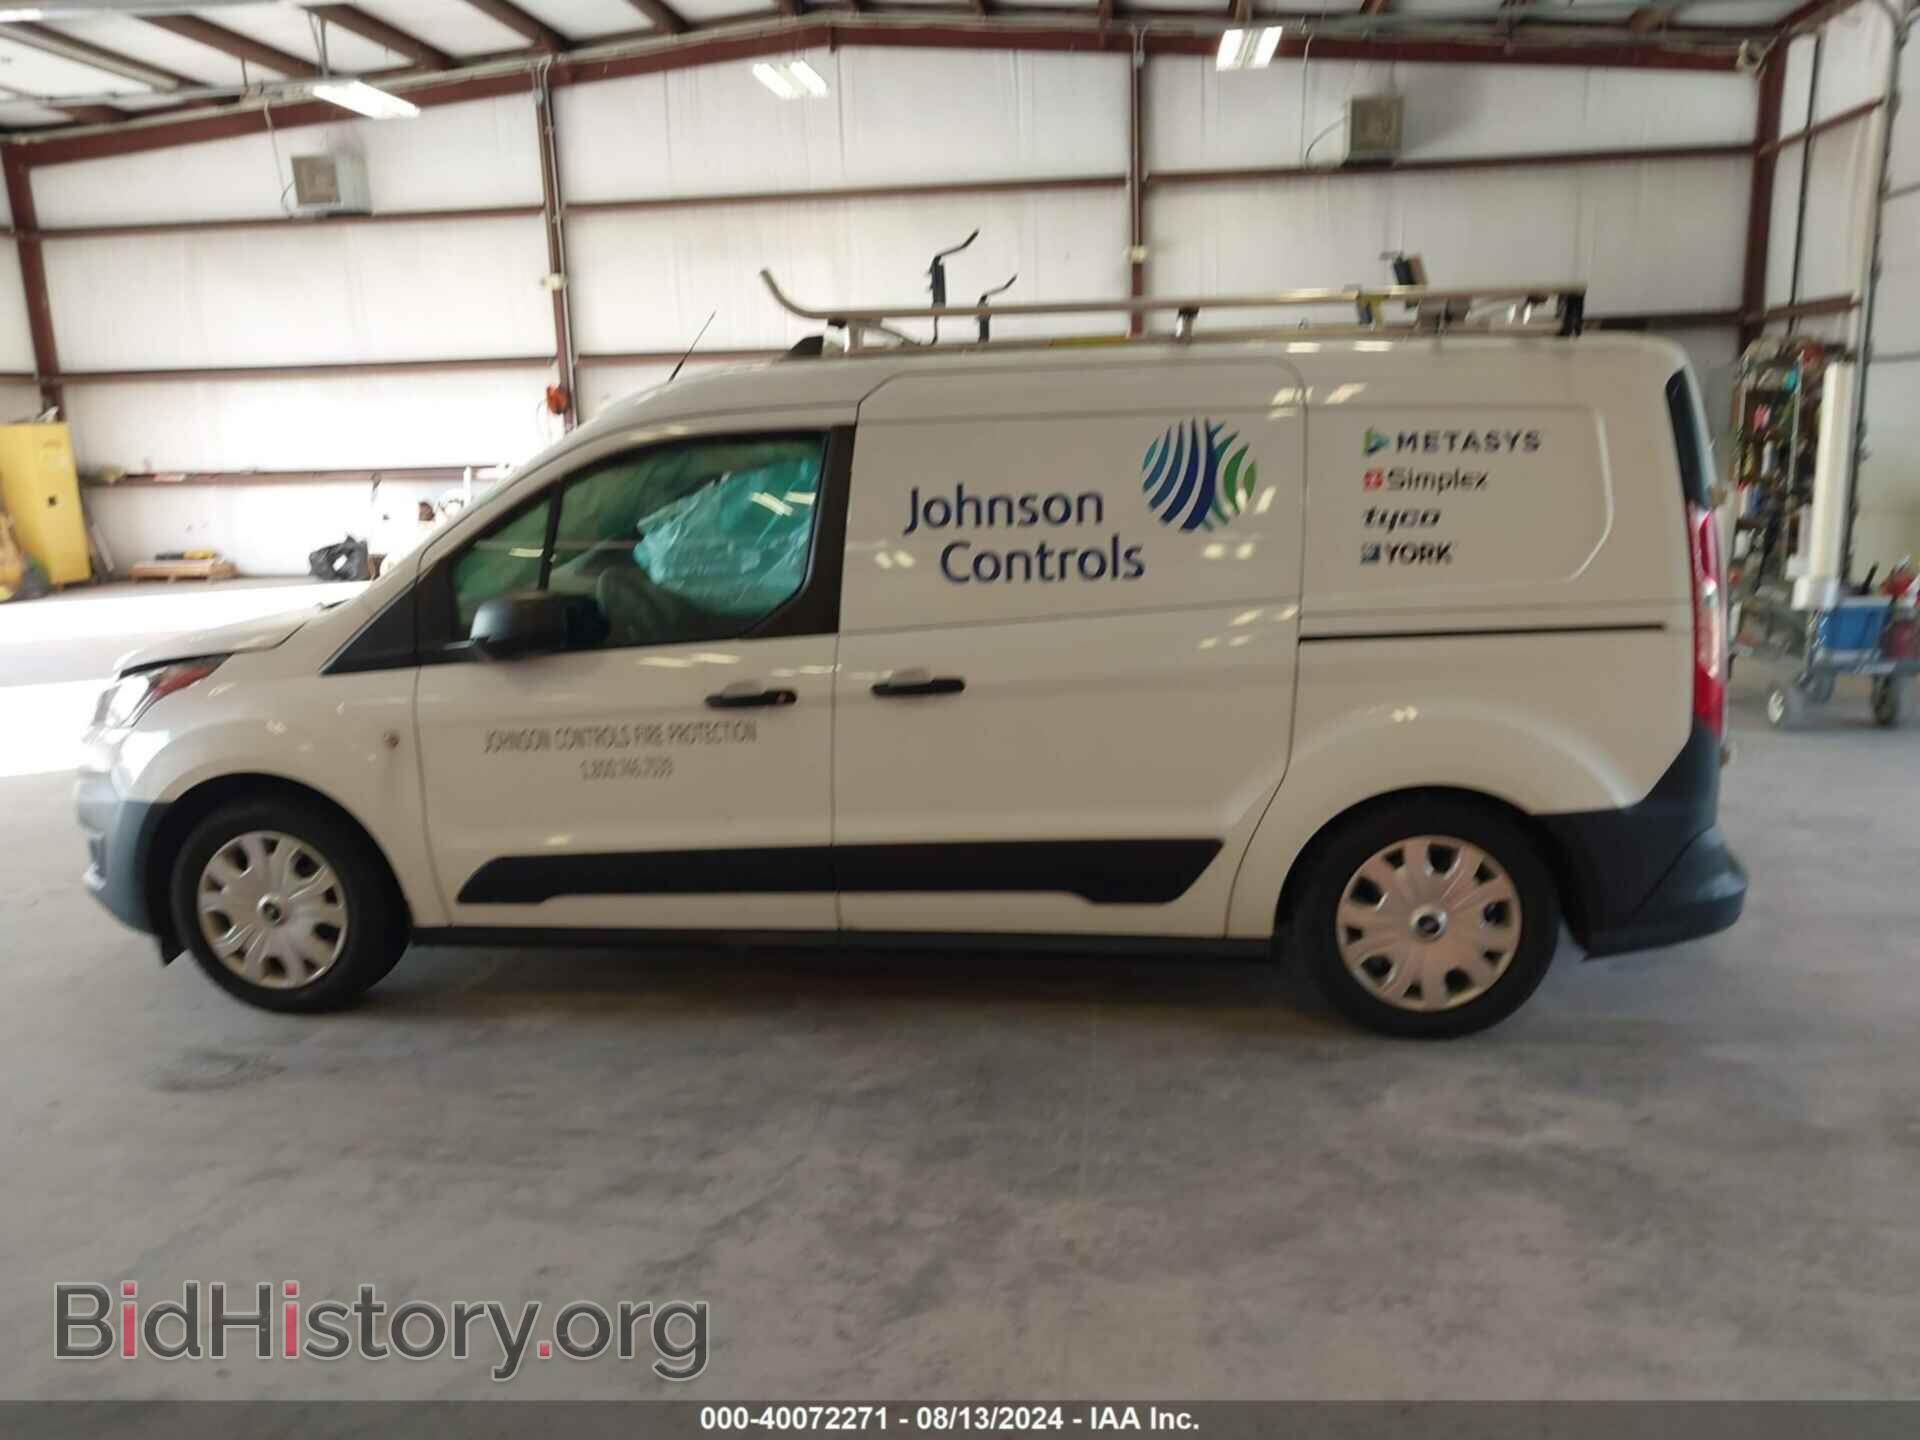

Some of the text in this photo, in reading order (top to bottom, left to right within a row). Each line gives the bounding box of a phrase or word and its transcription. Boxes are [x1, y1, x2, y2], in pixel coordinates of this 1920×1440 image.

[1396, 430, 1542, 453] METASYS
[1386, 466, 1488, 494] Simplex
[903, 483, 1105, 535] Johnson
[940, 534, 1146, 583] Controls
[1385, 542, 1453, 565] YORK
[484, 719, 759, 753] JOHNSON CONTROLS FIRE PROTECTION
